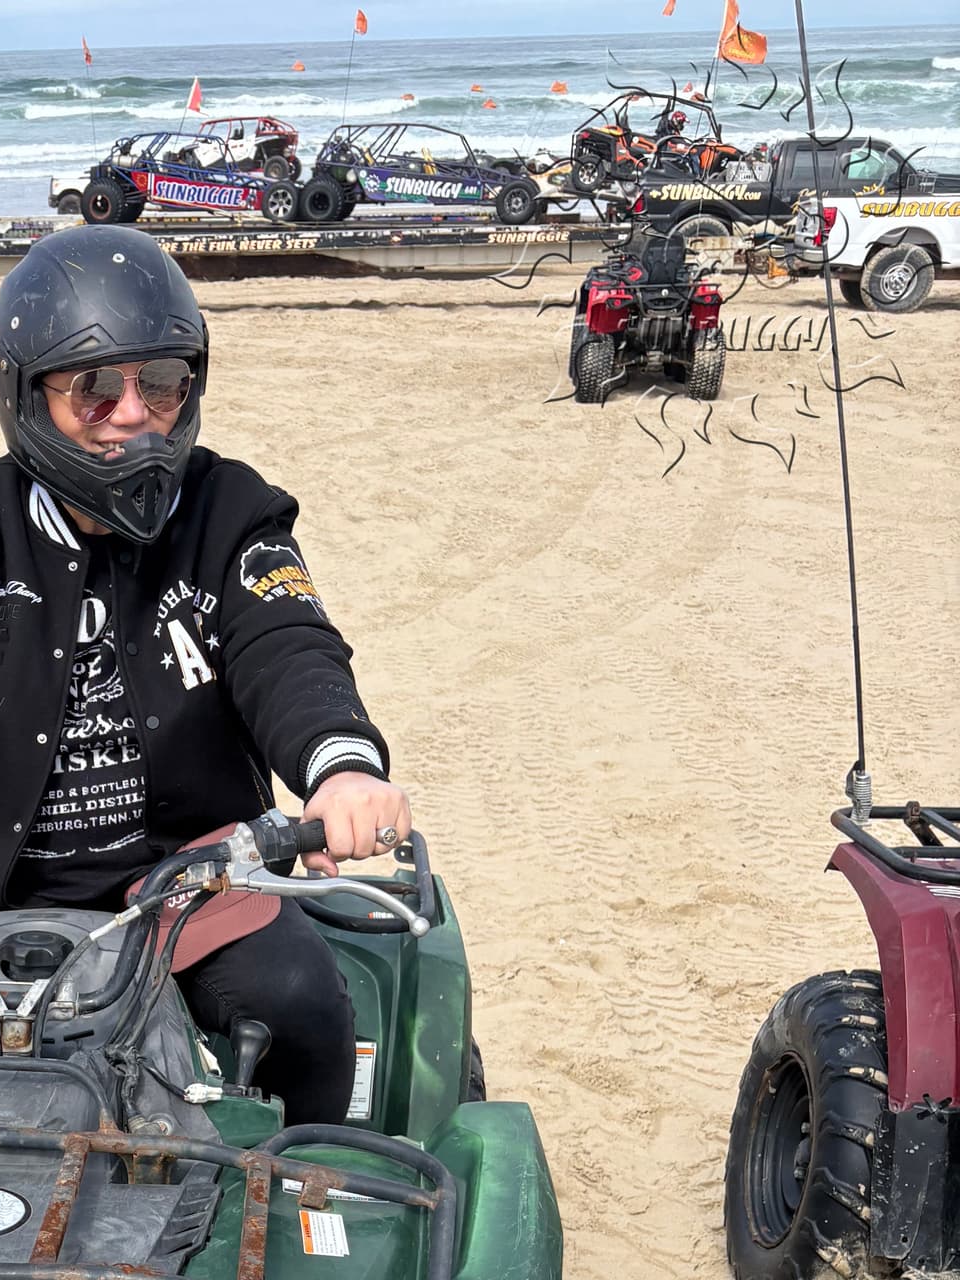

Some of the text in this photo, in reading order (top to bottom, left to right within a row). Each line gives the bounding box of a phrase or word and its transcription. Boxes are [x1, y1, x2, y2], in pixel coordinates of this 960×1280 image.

[156, 181, 243, 206] SUNBUGGIE
[385, 177, 462, 198] SUNBUGGY
[181, 241, 206, 252] THE
[208, 240, 237, 251] FUN
[239, 239, 282, 250] NEVER
[286, 238, 318, 249] SETS
[43, 789, 64, 800] ED
[69, 787, 78, 797] &
[82, 778, 138, 796] BOTTLED
[31, 818, 89, 832] HBURG,
[89, 811, 131, 827] TENN.
